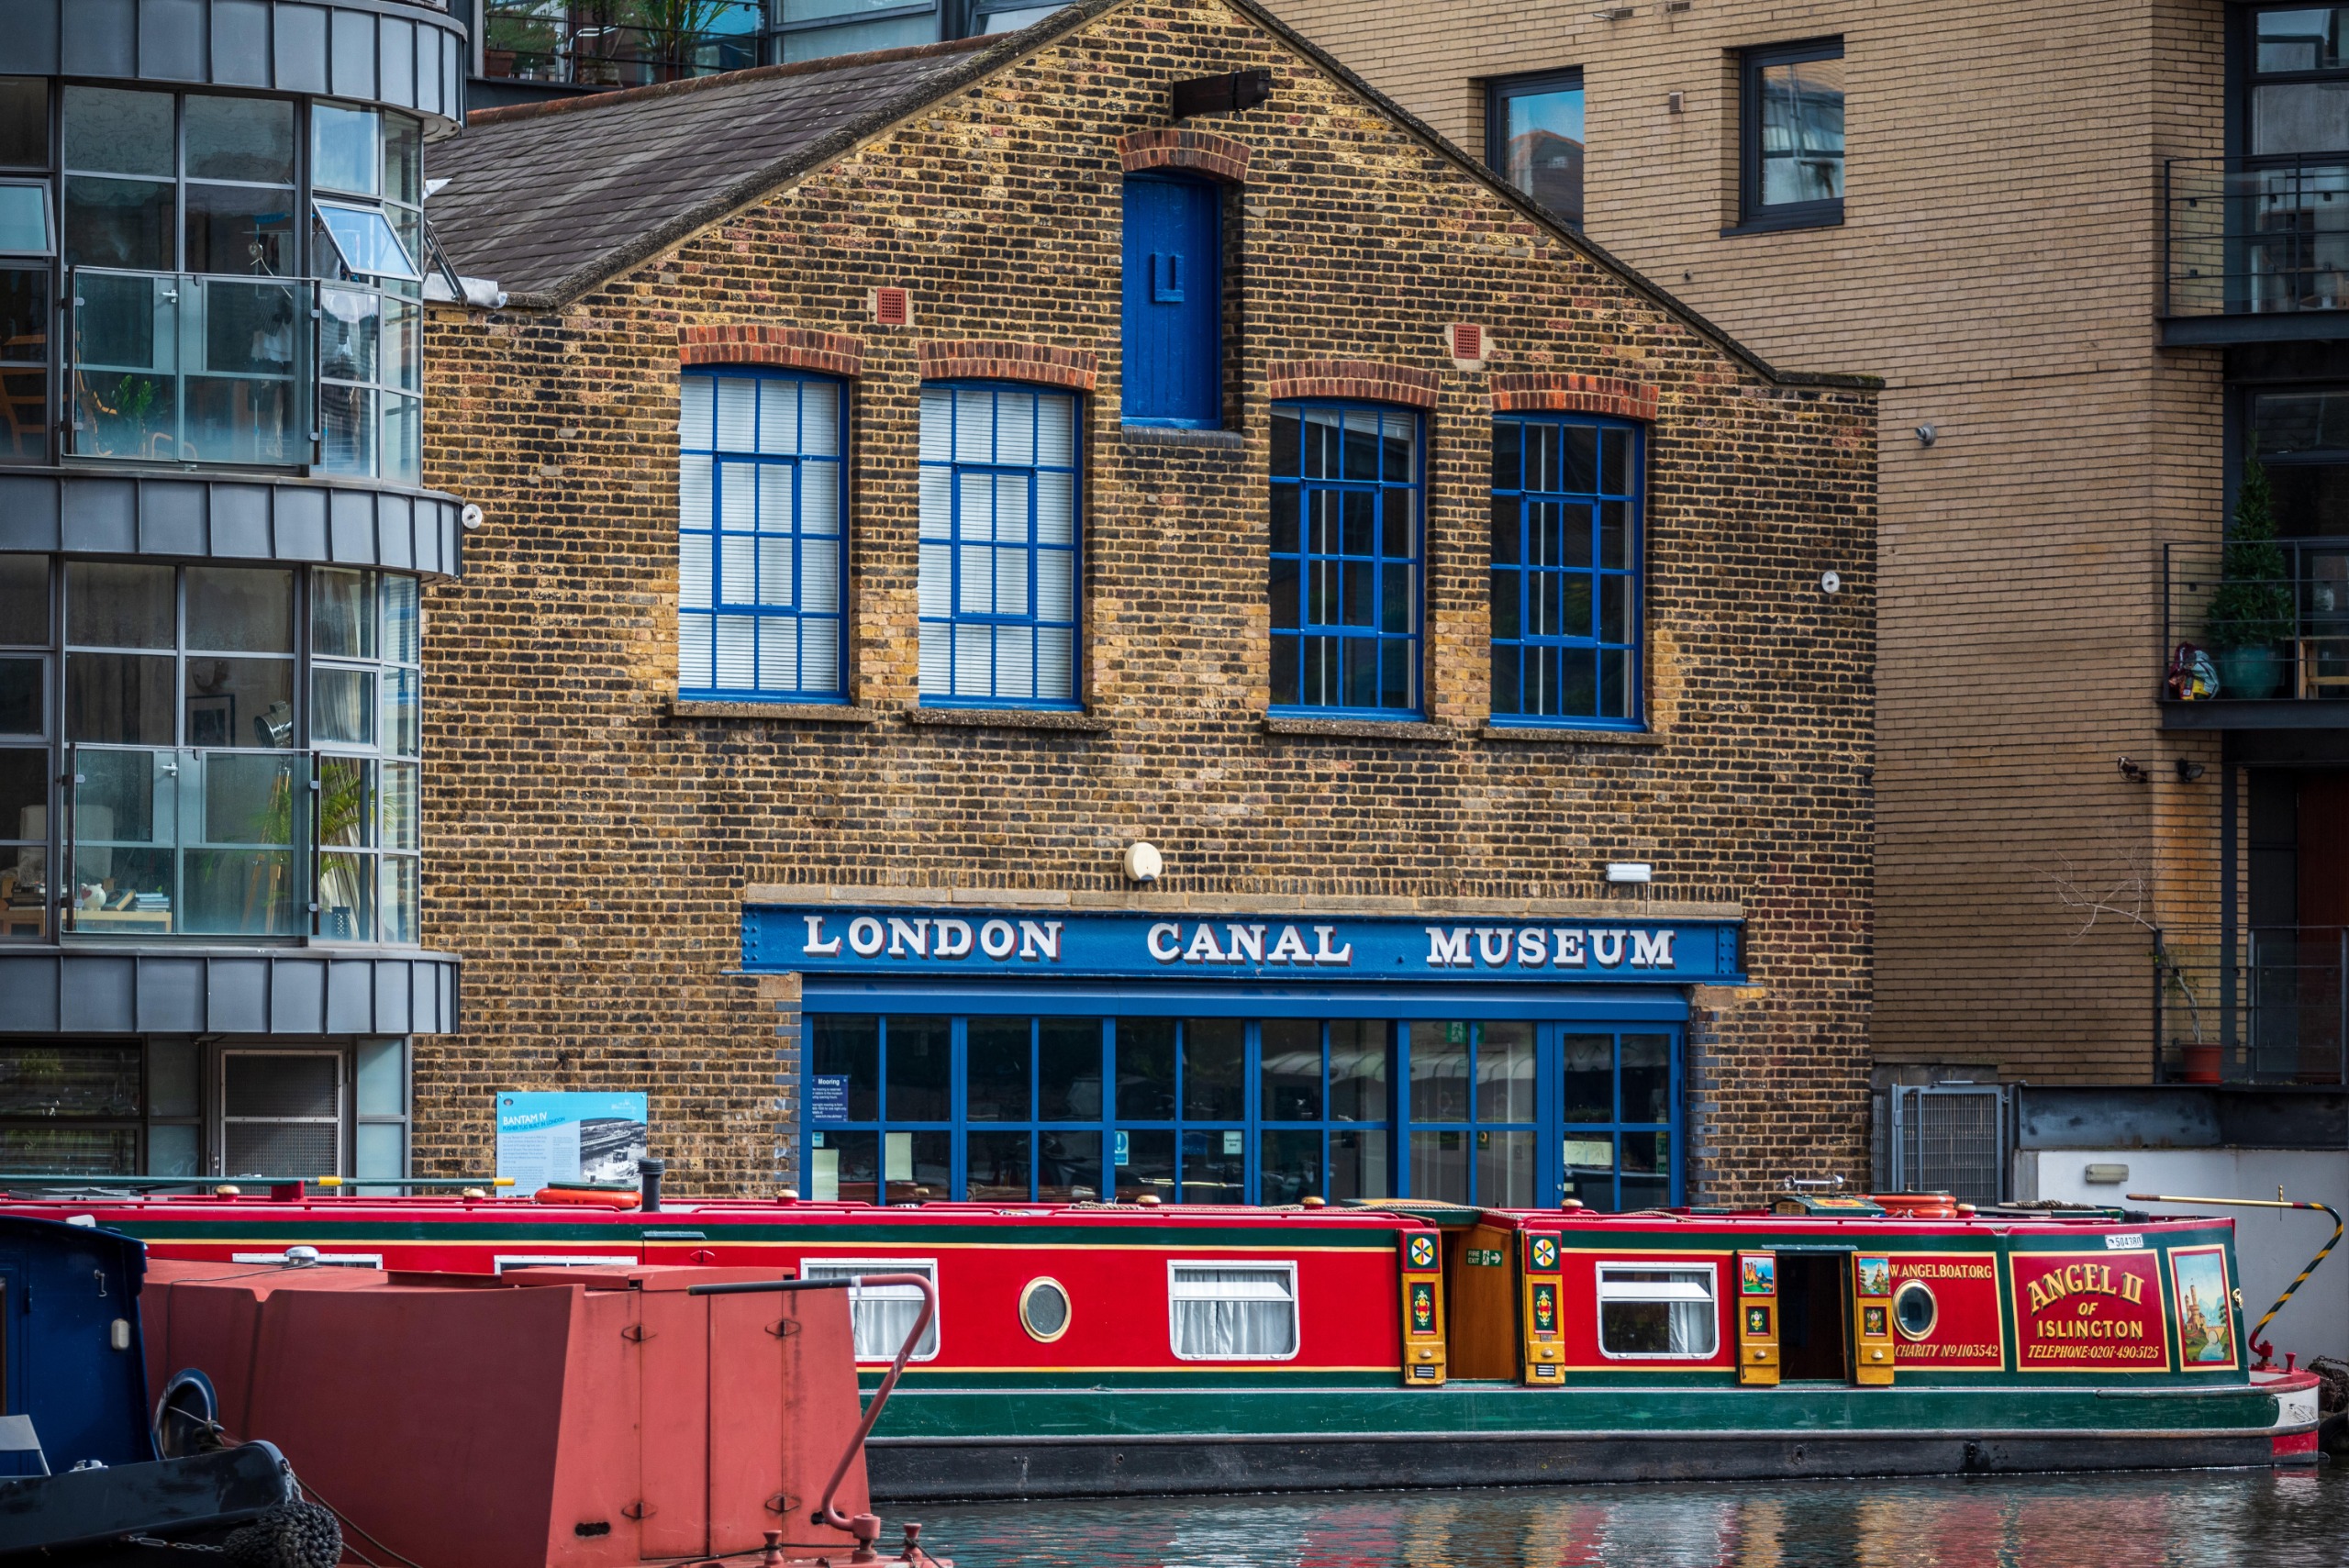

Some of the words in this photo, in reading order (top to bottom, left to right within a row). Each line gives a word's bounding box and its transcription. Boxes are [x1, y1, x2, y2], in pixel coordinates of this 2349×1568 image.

[803, 916, 1063, 961] LONDON
[1147, 923, 1353, 966] CANAL
[1425, 927, 1676, 969] MUSEUM
[503, 1113, 538, 1125] BANTAM
[539, 1111, 547, 1120] IV
[547, 1117, 566, 1126] LONDON
[2027, 1262, 2117, 1317] ANGEL
[2119, 1272, 2145, 1305] II
[2077, 1302, 2099, 1316] OF
[2036, 1320, 2143, 1340] ISLINGTON
[1895, 1344, 1940, 1358] CHARITY
